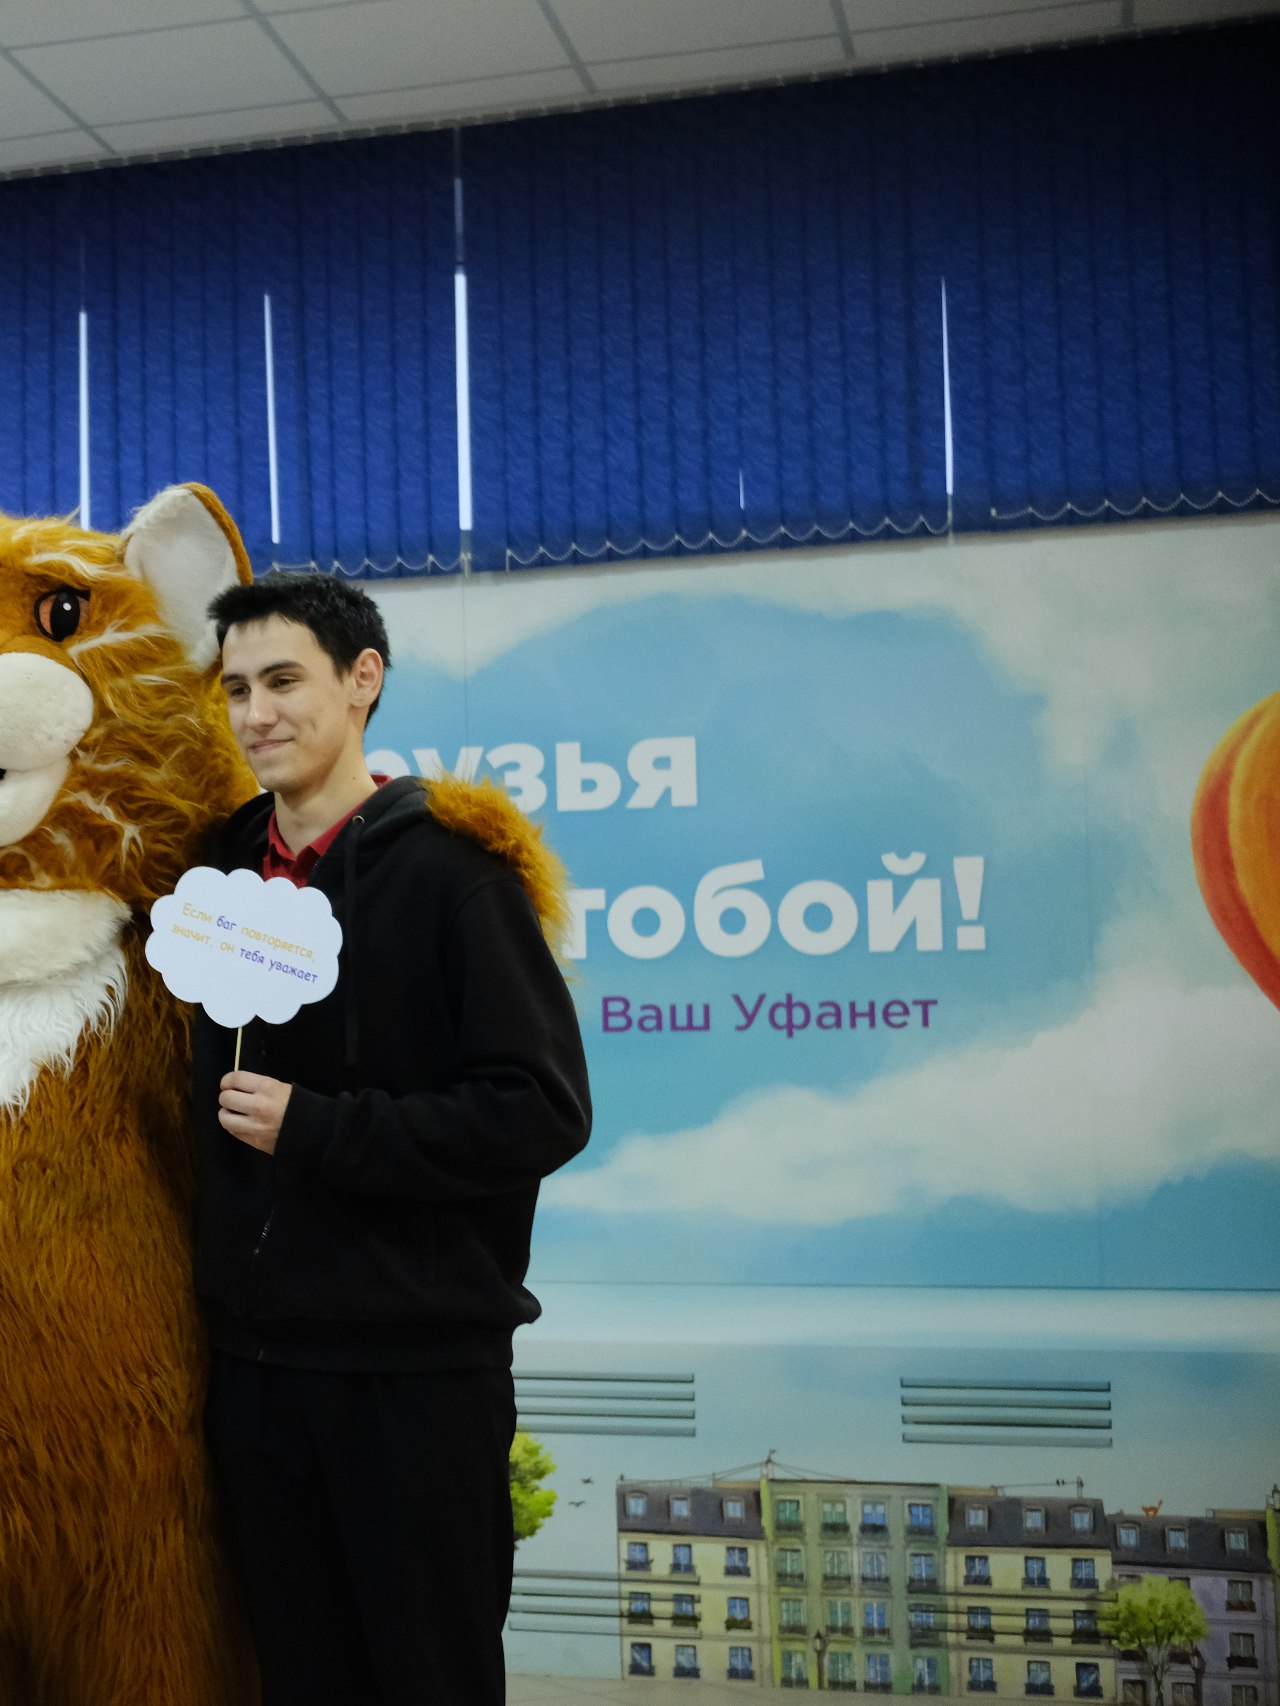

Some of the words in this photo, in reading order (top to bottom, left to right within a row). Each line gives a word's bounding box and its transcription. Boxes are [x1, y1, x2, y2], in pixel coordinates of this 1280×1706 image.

[182, 902, 213, 924] Если
[216, 915, 237, 932] баг
[220, 941, 235, 954] он
[240, 947, 265, 965] тебя
[269, 957, 318, 984] уважает
[602, 996, 711, 1034] Ваш
[732, 993, 938, 1039] Уфанет
